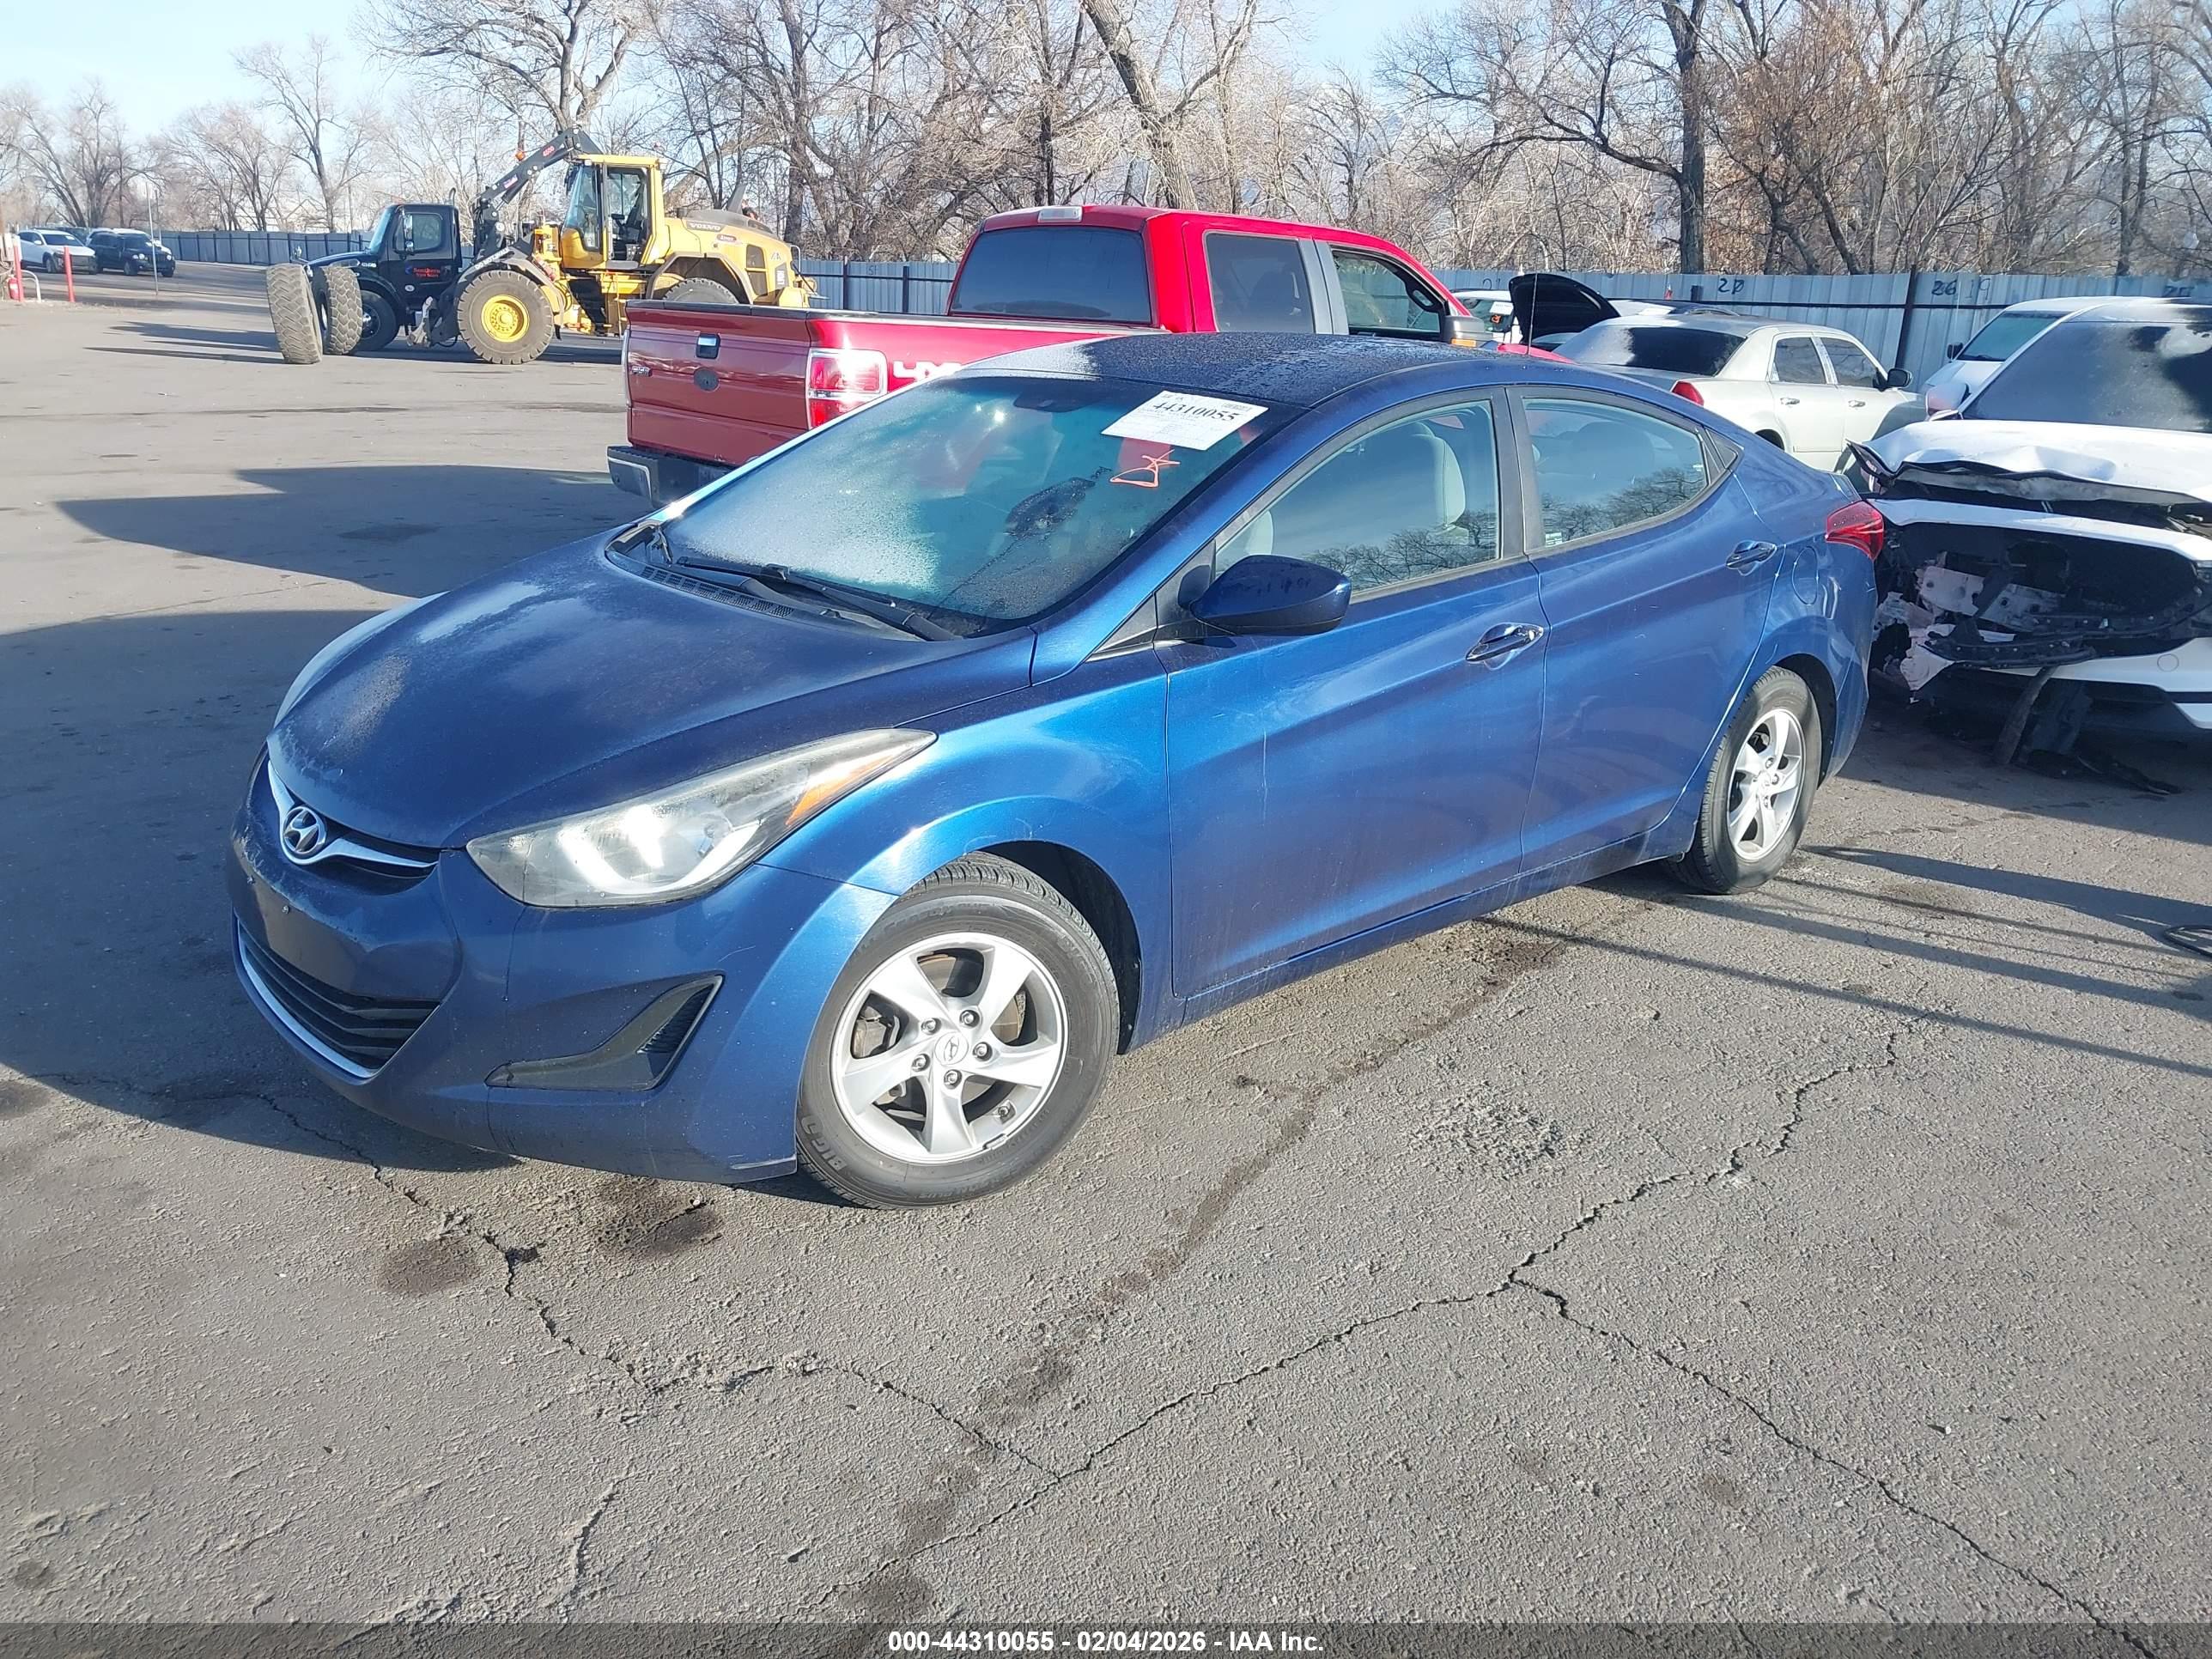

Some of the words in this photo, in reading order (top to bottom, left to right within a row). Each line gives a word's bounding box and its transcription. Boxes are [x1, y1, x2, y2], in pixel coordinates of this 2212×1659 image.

[690, 222, 721, 231] VOLVO
[1153, 402, 1242, 421] 44310055
[811, 1137, 848, 1170] BIG
